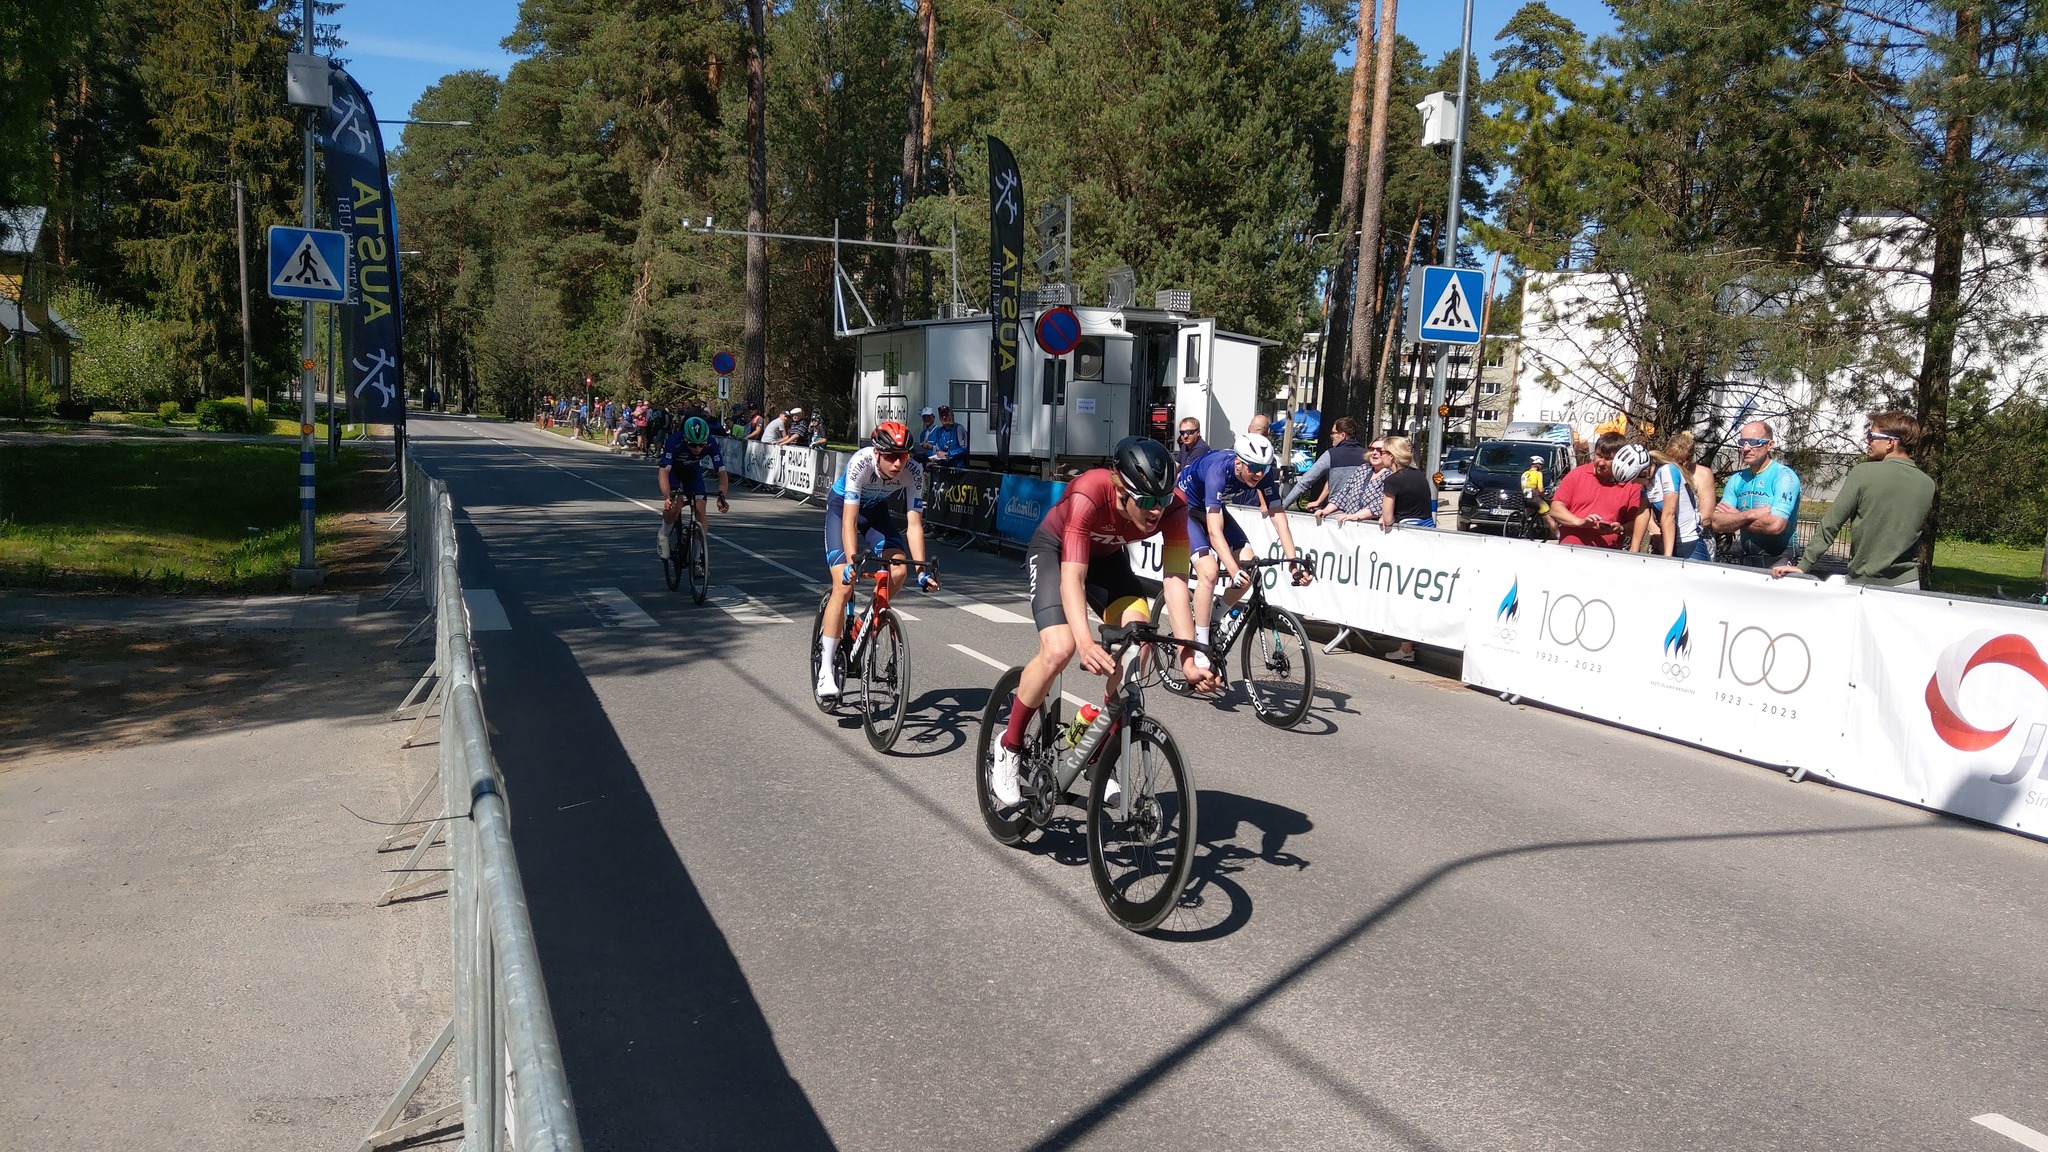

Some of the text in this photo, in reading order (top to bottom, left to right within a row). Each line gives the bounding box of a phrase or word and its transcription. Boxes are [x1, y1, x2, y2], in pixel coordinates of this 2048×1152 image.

[1540, 410, 1578, 422] ELVA
[1370, 551, 1461, 604] invest
[1538, 590, 1616, 652] 100
[1536, 651, 1559, 664] 1923
[1574, 659, 1602, 673] 2023
[1717, 620, 1812, 695] 100
[1714, 691, 1742, 706] 1923
[1761, 702, 1797, 720] 2023
